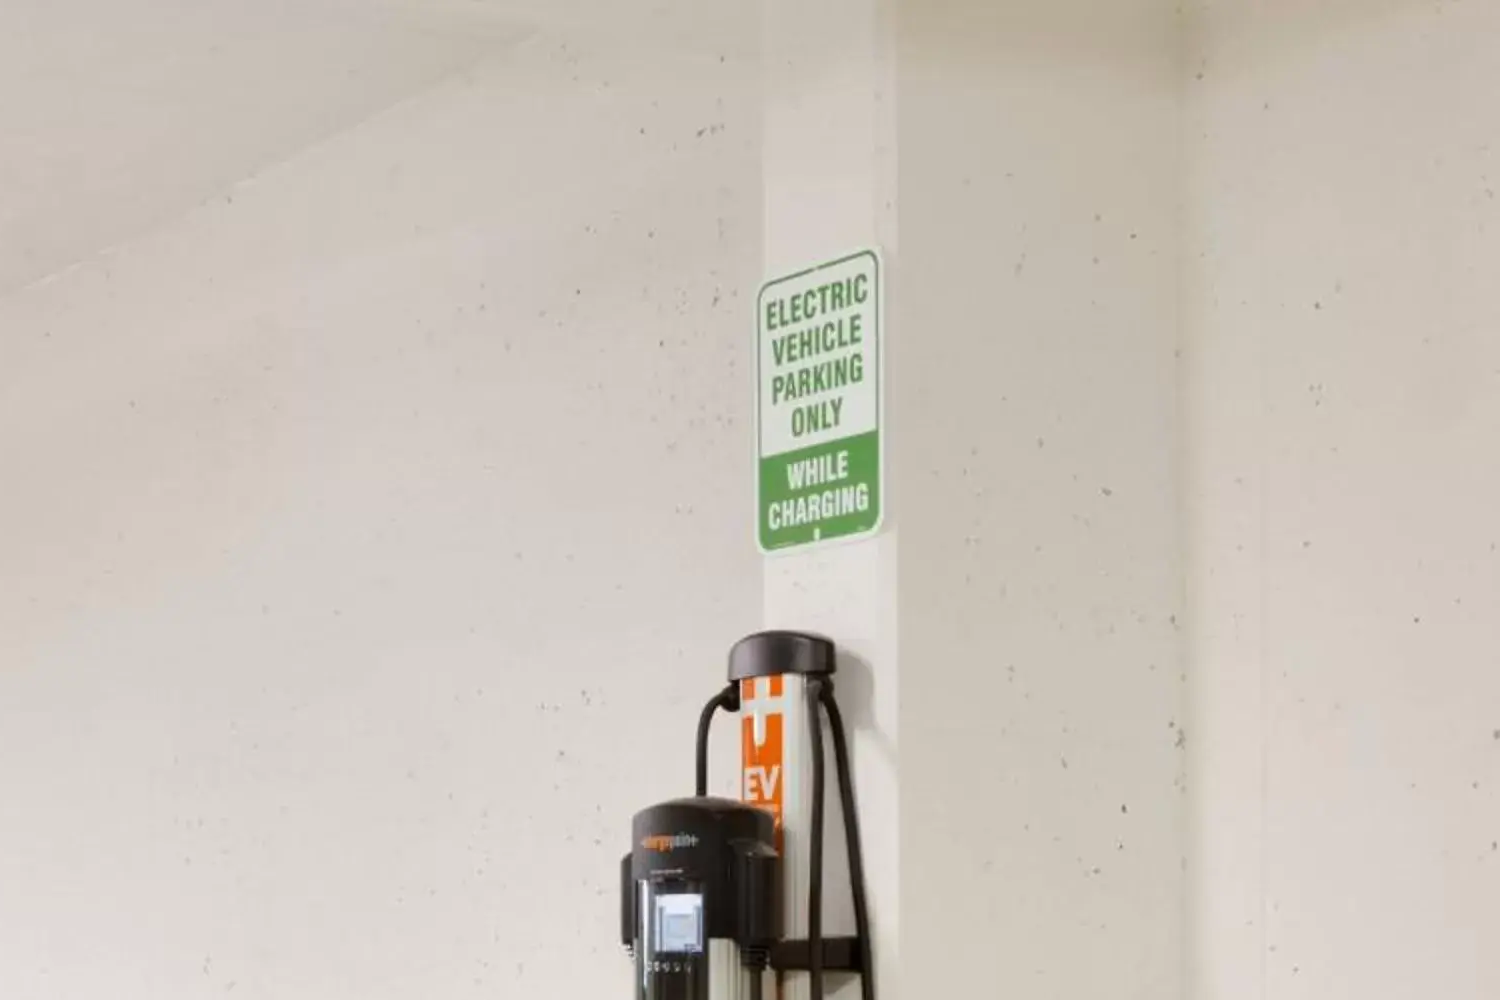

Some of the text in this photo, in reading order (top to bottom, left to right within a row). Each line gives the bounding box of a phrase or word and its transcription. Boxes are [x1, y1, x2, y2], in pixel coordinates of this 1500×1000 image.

[766, 273, 868, 330] ELECTRIC
[772, 314, 861, 365] VEHICLE
[772, 354, 863, 404] PARKING
[791, 398, 843, 437] ONLY
[787, 451, 848, 490] WHILE
[768, 483, 869, 530] CHARGING
[744, 765, 780, 800] EV
